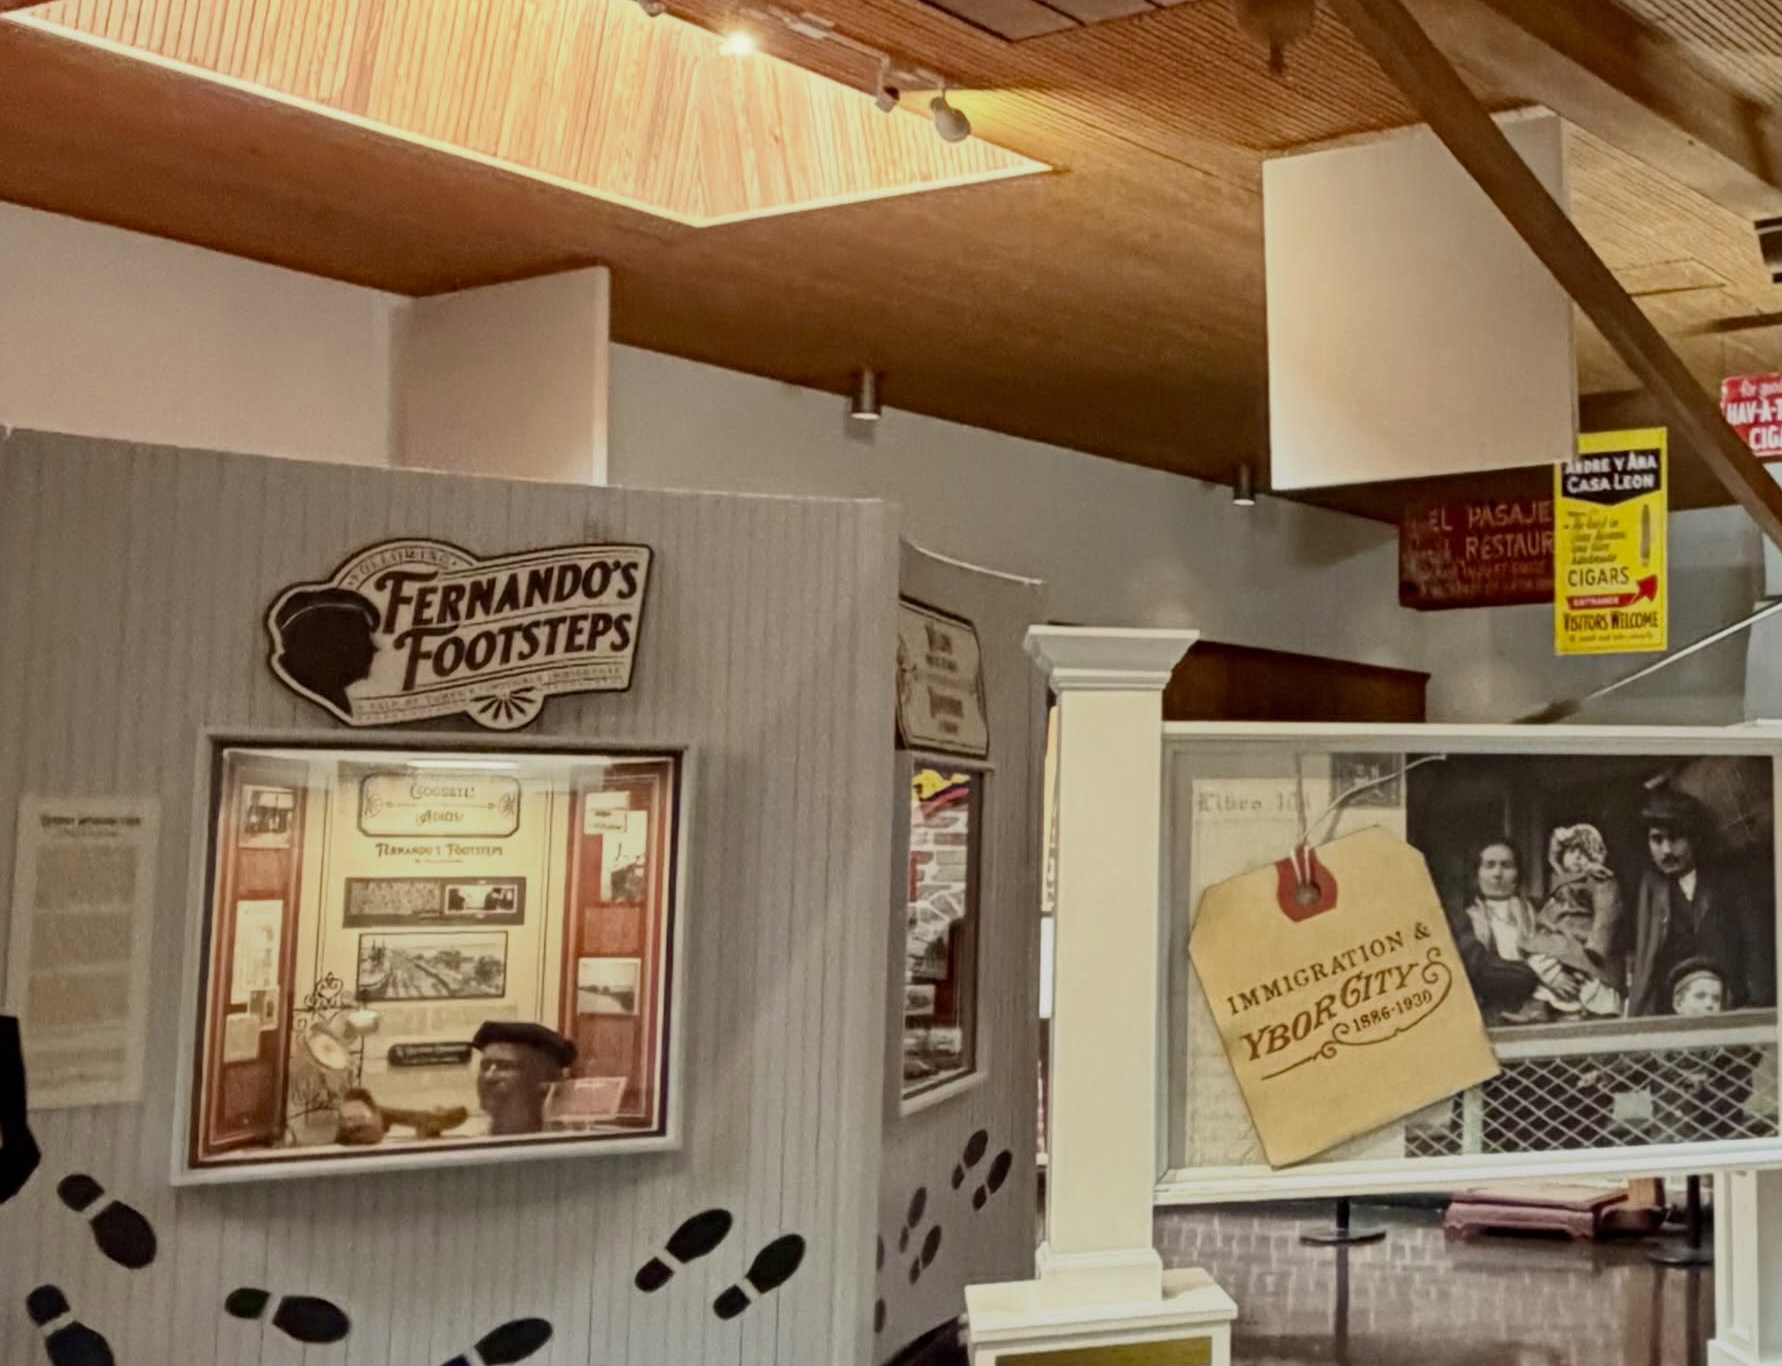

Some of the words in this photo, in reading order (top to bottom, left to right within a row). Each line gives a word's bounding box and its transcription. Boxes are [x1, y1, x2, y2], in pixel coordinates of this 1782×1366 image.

[1564, 457, 1611, 475] ANDRE
[1566, 475, 1611, 494] CASA
[1613, 473, 1655, 490] LEON
[1428, 506, 1454, 532] EL
[1466, 499, 1553, 531] PASAJE
[1567, 566, 1629, 587] CIGARS
[374, 560, 639, 635] FERNANDO'S
[1562, 612, 1609, 632] VISITORS
[1610, 611, 1659, 630] WELCOME
[393, 612, 633, 691] FOOTSTEPS
[1226, 930, 1405, 1017] IMMIGRATION
[1413, 921, 1432, 941] &
[1239, 993, 1338, 1062] YBOR
[1339, 962, 1420, 1010] CITY
[1352, 988, 1433, 1033] 1886-1930
